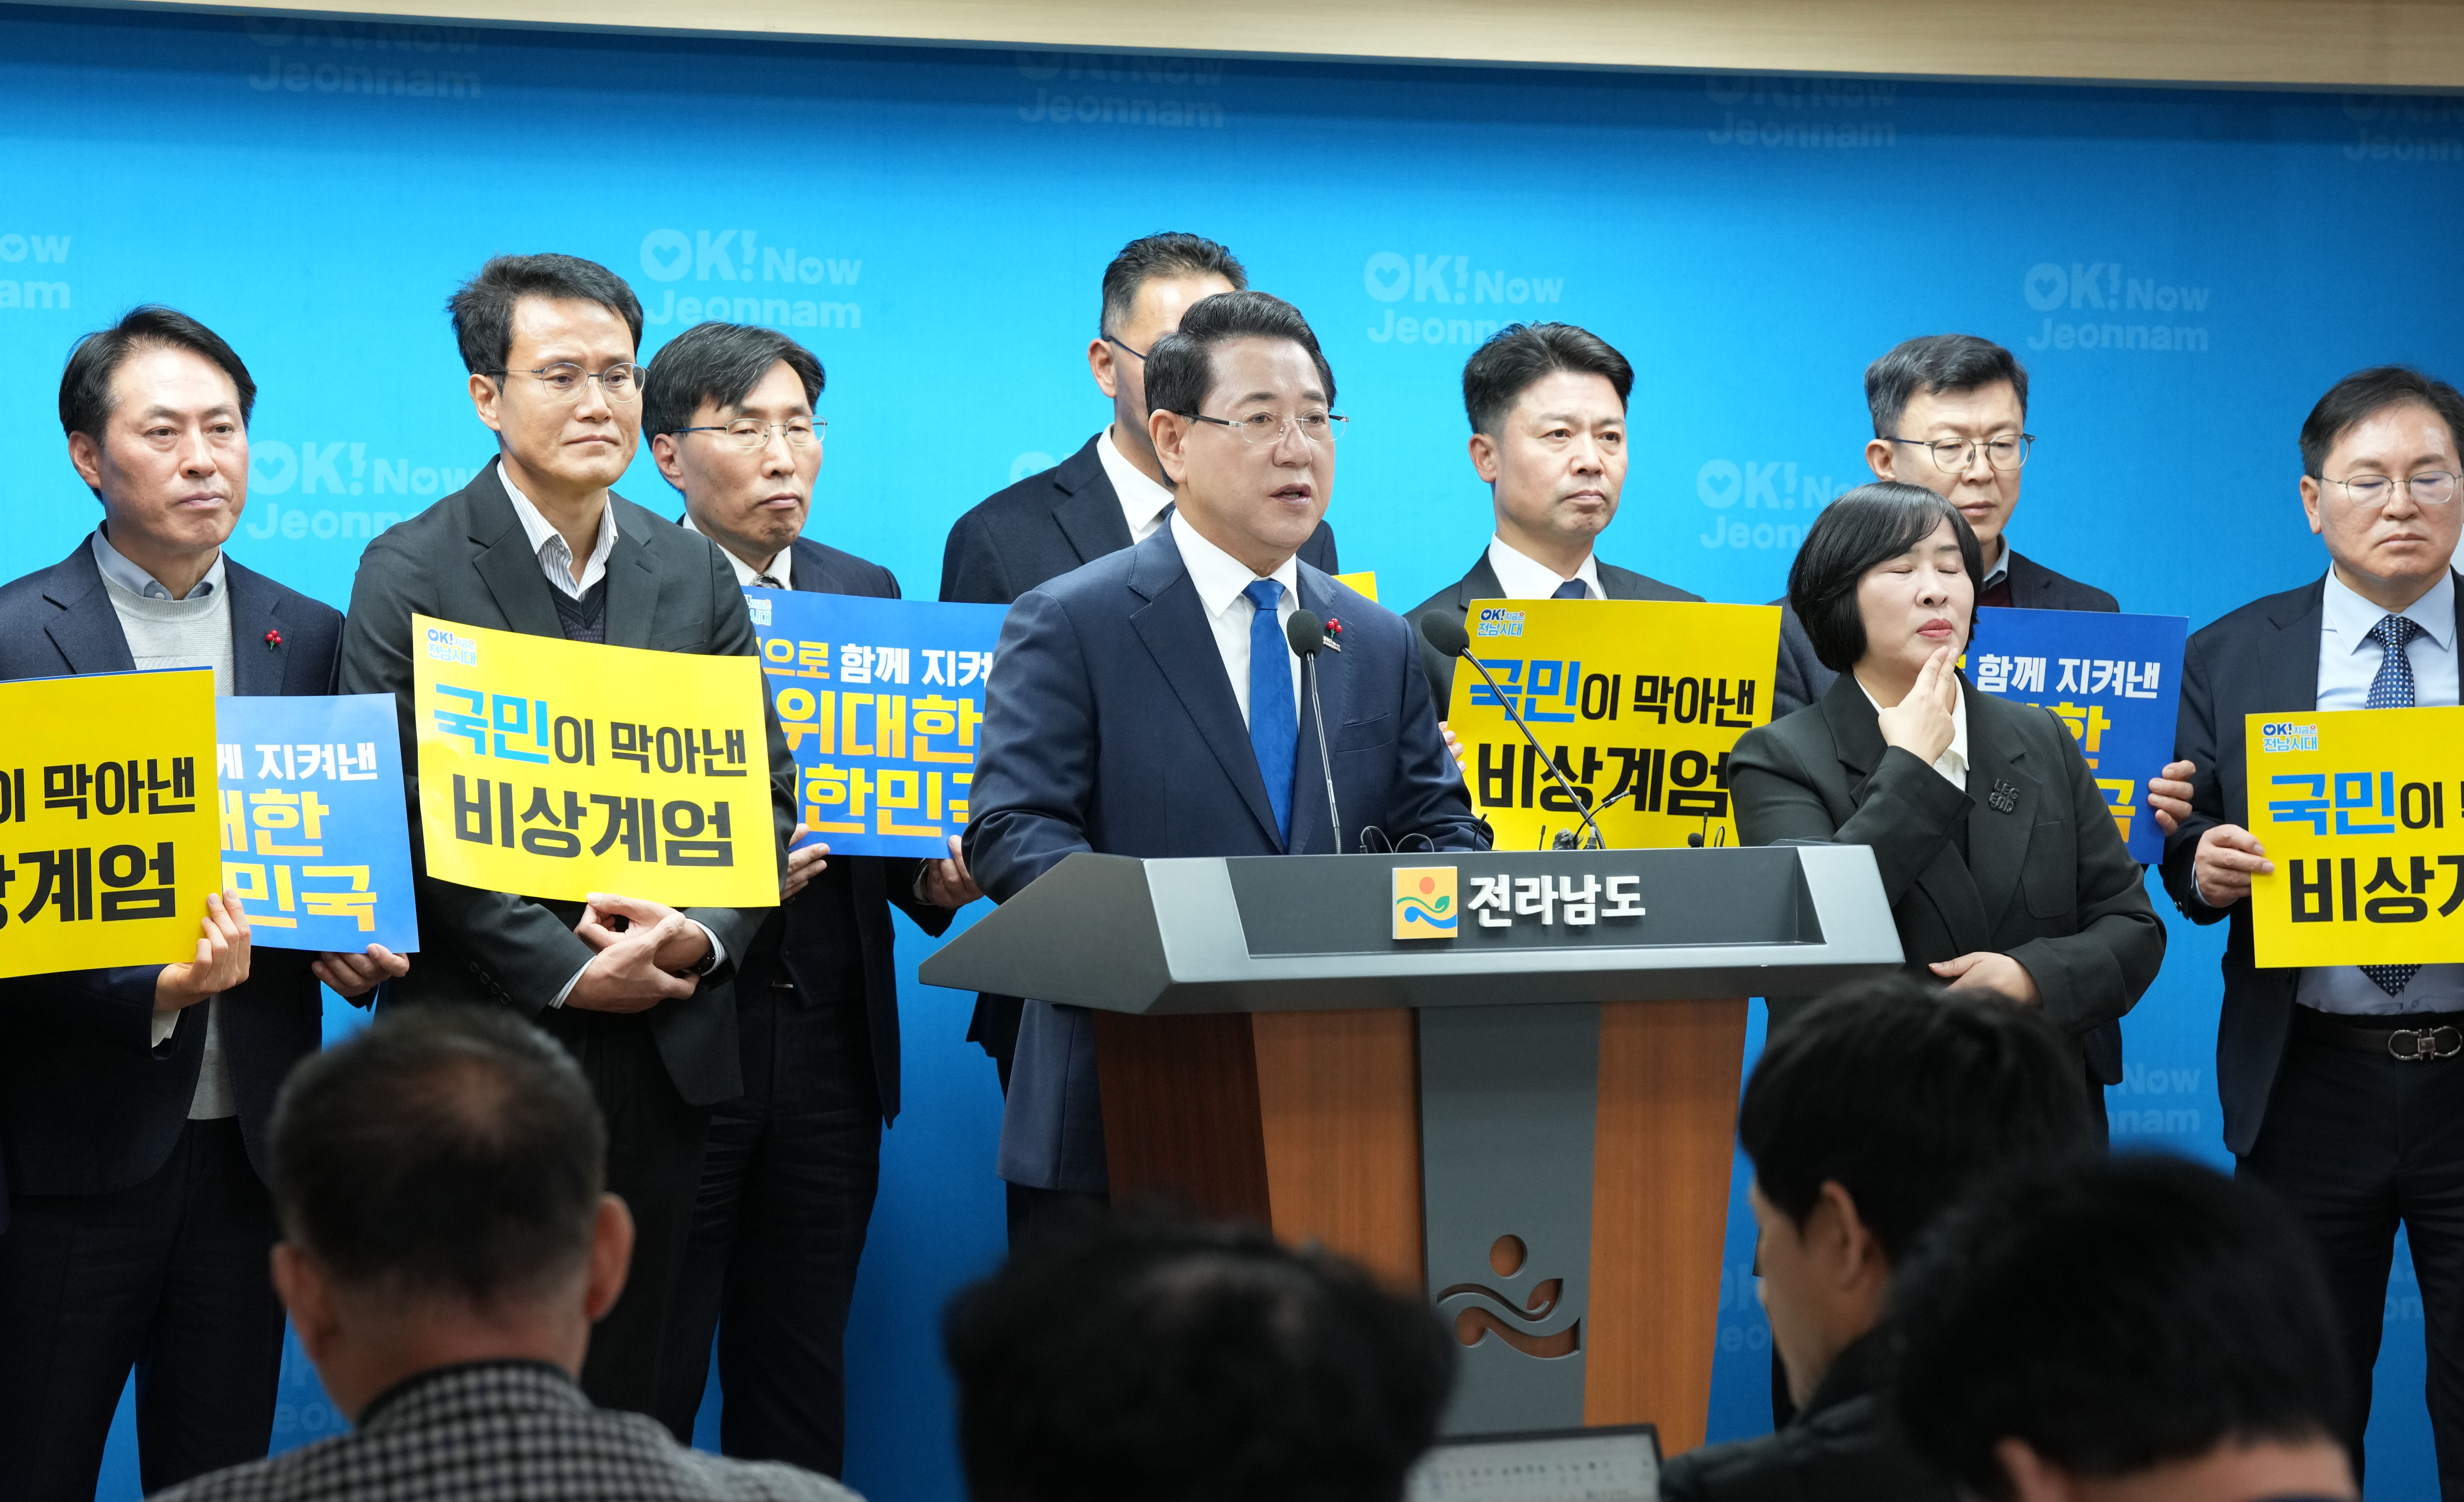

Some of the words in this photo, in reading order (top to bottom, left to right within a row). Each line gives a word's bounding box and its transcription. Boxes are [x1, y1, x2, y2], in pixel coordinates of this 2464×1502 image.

[249, 54, 481, 98] Jeonnam
[1017, 88, 1225, 128] Jeonnam
[1707, 112, 1896, 148] Jeonnam
[2343, 128, 2464, 161] Jeonn
[0, 233, 72, 263] ow
[640, 228, 757, 283] OK!
[1363, 251, 1470, 305] OK!
[2024, 262, 2122, 311] OK!
[645, 289, 862, 329] Jeonnam
[1366, 308, 1520, 344] Jeonn
[2026, 317, 2209, 351] Jeonnam
[249, 440, 367, 496] OK!
[1697, 458, 1798, 511] OK!
[247, 503, 421, 540] Jeonn
[1700, 515, 1812, 549] Jeon
[750, 611, 770, 625] 시대
[1478, 622, 1523, 636] 전남시대
[1481, 609, 1506, 620] OK!
[1505, 612, 1524, 620] 지금은
[427, 629, 452, 645] OK!
[455, 638, 475, 649] 지금은
[429, 644, 476, 665] 전남시대
[757, 637, 830, 679] 으로
[840, 643, 909, 685] 함께
[921, 650, 994, 687] 지켜
[1469, 659, 1621, 722] 국민이
[1634, 675, 1755, 728] 막아낸
[1977, 653, 2047, 693] 함께
[2055, 658, 2161, 699] 지켜낸
[434, 683, 595, 766] 국민이
[610, 721, 747, 777] 막아낸
[776, 688, 983, 764] 위대한
[2263, 724, 2292, 736] OK!
[2294, 725, 2317, 735] 지금은
[2264, 736, 2317, 752] 전남시대
[255, 742, 378, 781] 지켜낸
[1478, 743, 1731, 818] 비상계엄
[44, 757, 195, 820] 막아낸
[794, 763, 974, 837] 한민
[2269, 771, 2444, 836] 국민이
[452, 774, 734, 867] 비상계엄
[0, 841, 176, 929] 계엄
[222, 862, 377, 932] 민국
[1468, 874, 1646, 927] 전라남도
[2289, 855, 2464, 923] 비상
